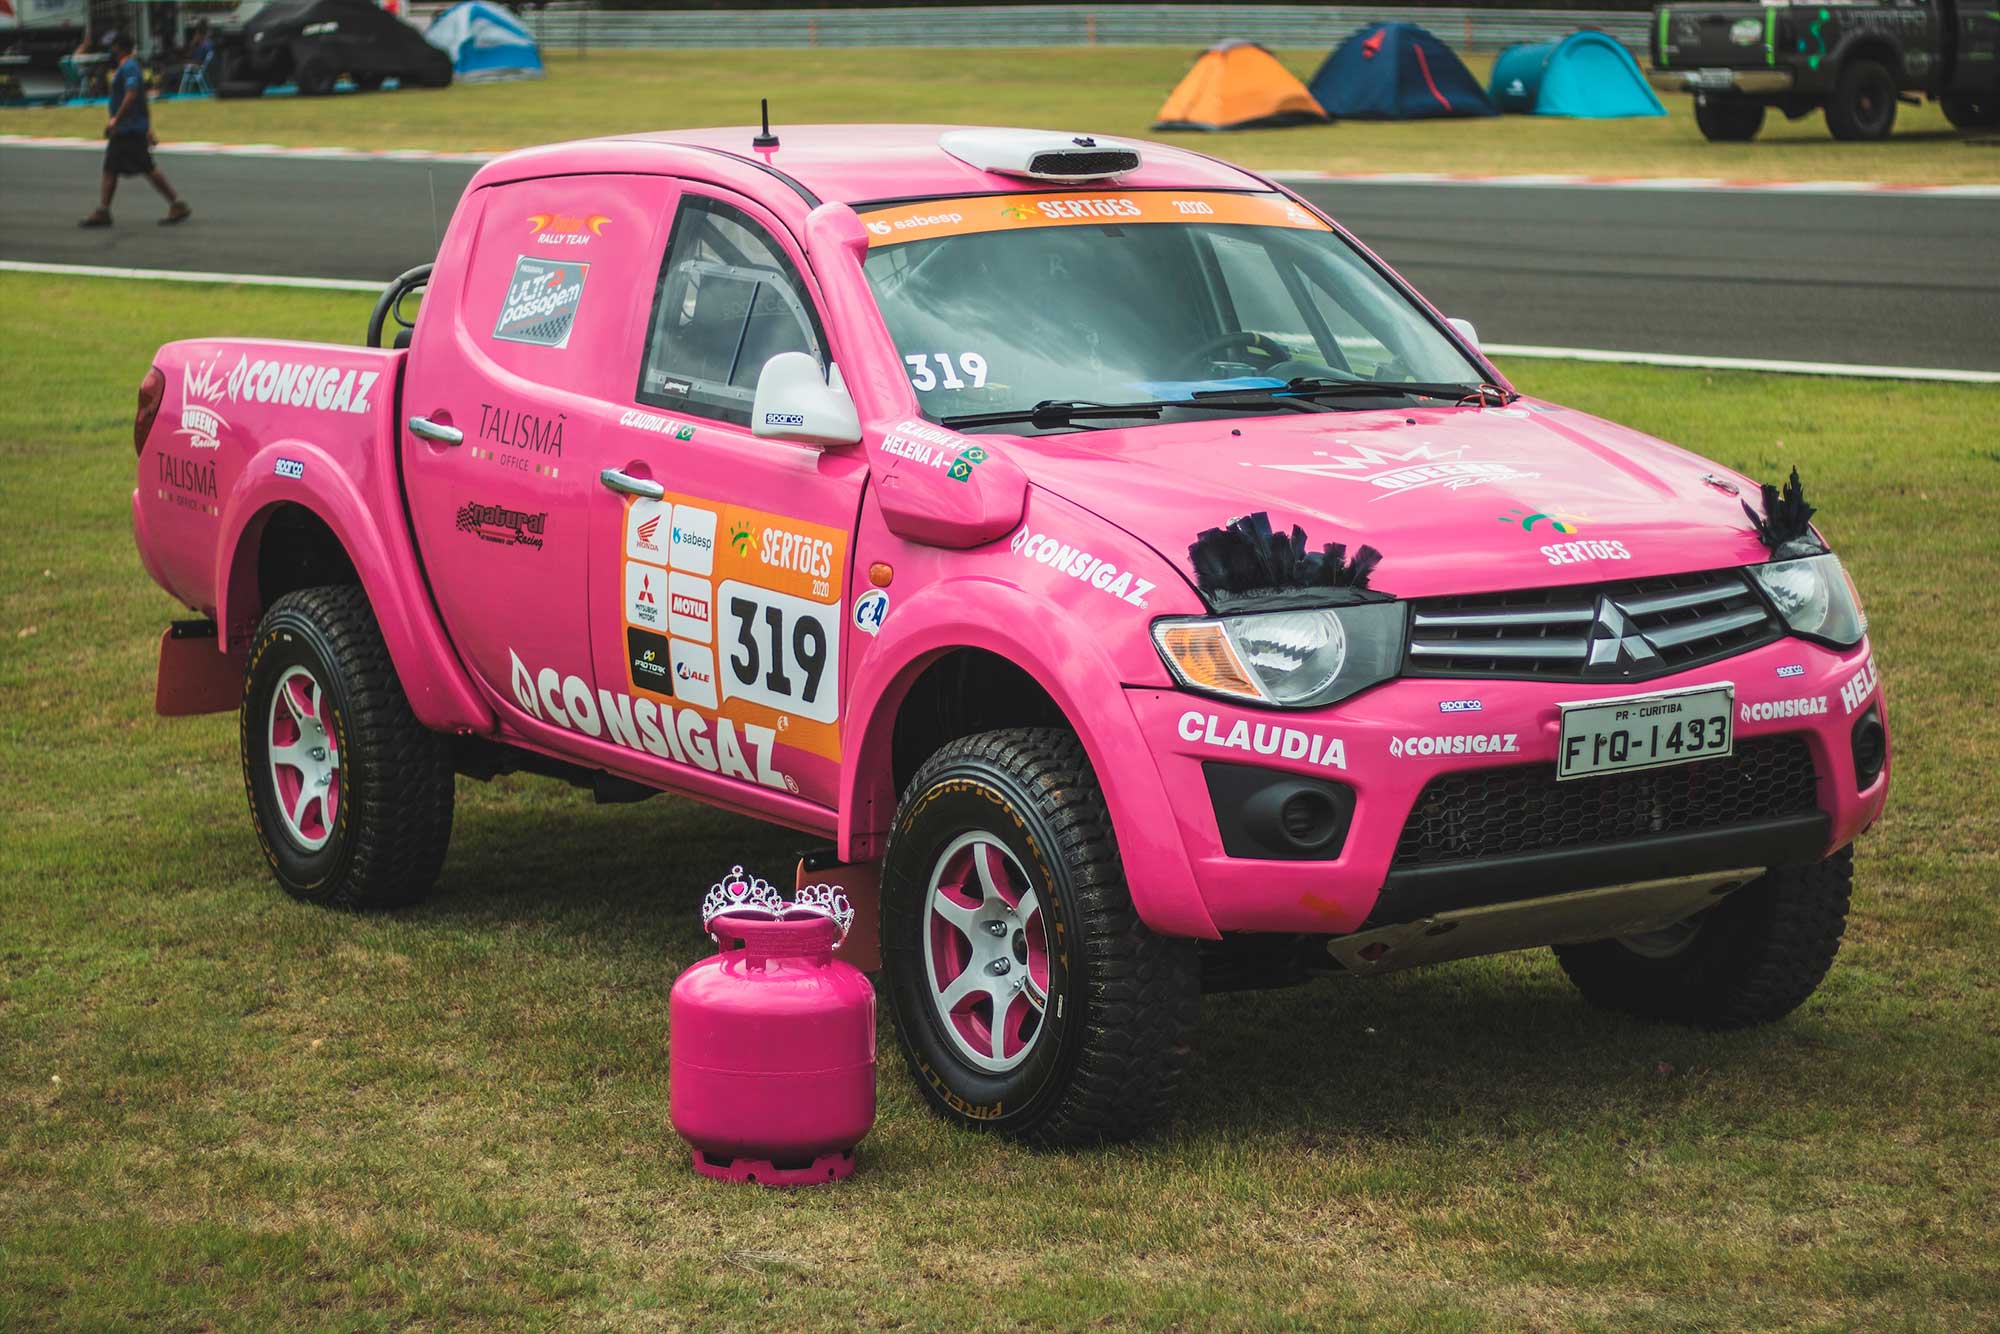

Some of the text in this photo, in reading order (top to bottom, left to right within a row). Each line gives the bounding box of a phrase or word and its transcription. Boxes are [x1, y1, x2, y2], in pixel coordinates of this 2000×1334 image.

[1172, 200, 1214, 215] 2020
[894, 213, 962, 229] sabesp
[537, 234, 591, 245] RALLY TEAM
[905, 351, 989, 392] 319
[242, 359, 381, 414] CONSIGAZ
[181, 410, 219, 439] QUEENS
[619, 410, 662, 433] CLAUDIA
[767, 413, 804, 424] sparco
[480, 403, 567, 458] TALISMÃ
[895, 420, 950, 448] CLAUDIA
[880, 434, 931, 466] HELENA
[275, 459, 304, 475] sparco
[500, 453, 529, 472] OFFICE
[157, 452, 218, 499] TALISMÃ
[471, 503, 547, 535] natural
[514, 529, 544, 552] Racing
[636, 541, 659, 552] HONDA
[682, 531, 712, 551] sabesp
[1025, 533, 1157, 607] CONSIGAZ
[812, 579, 830, 598] 2020
[638, 612, 656, 623] MOTORS
[673, 596, 709, 620] MOTUL
[730, 596, 827, 703] 319
[690, 672, 710, 683] ALE
[1439, 700, 1482, 711] sparco
[1615, 710, 1630, 722] PR
[1639, 703, 1683, 718] CURITIBA
[1751, 696, 1828, 722] CONSIGAZ
[537, 667, 790, 790] CONSIGAZ
[1177, 711, 1347, 770] CLAUDIA
[1404, 733, 1518, 756] CONSIGAZ
